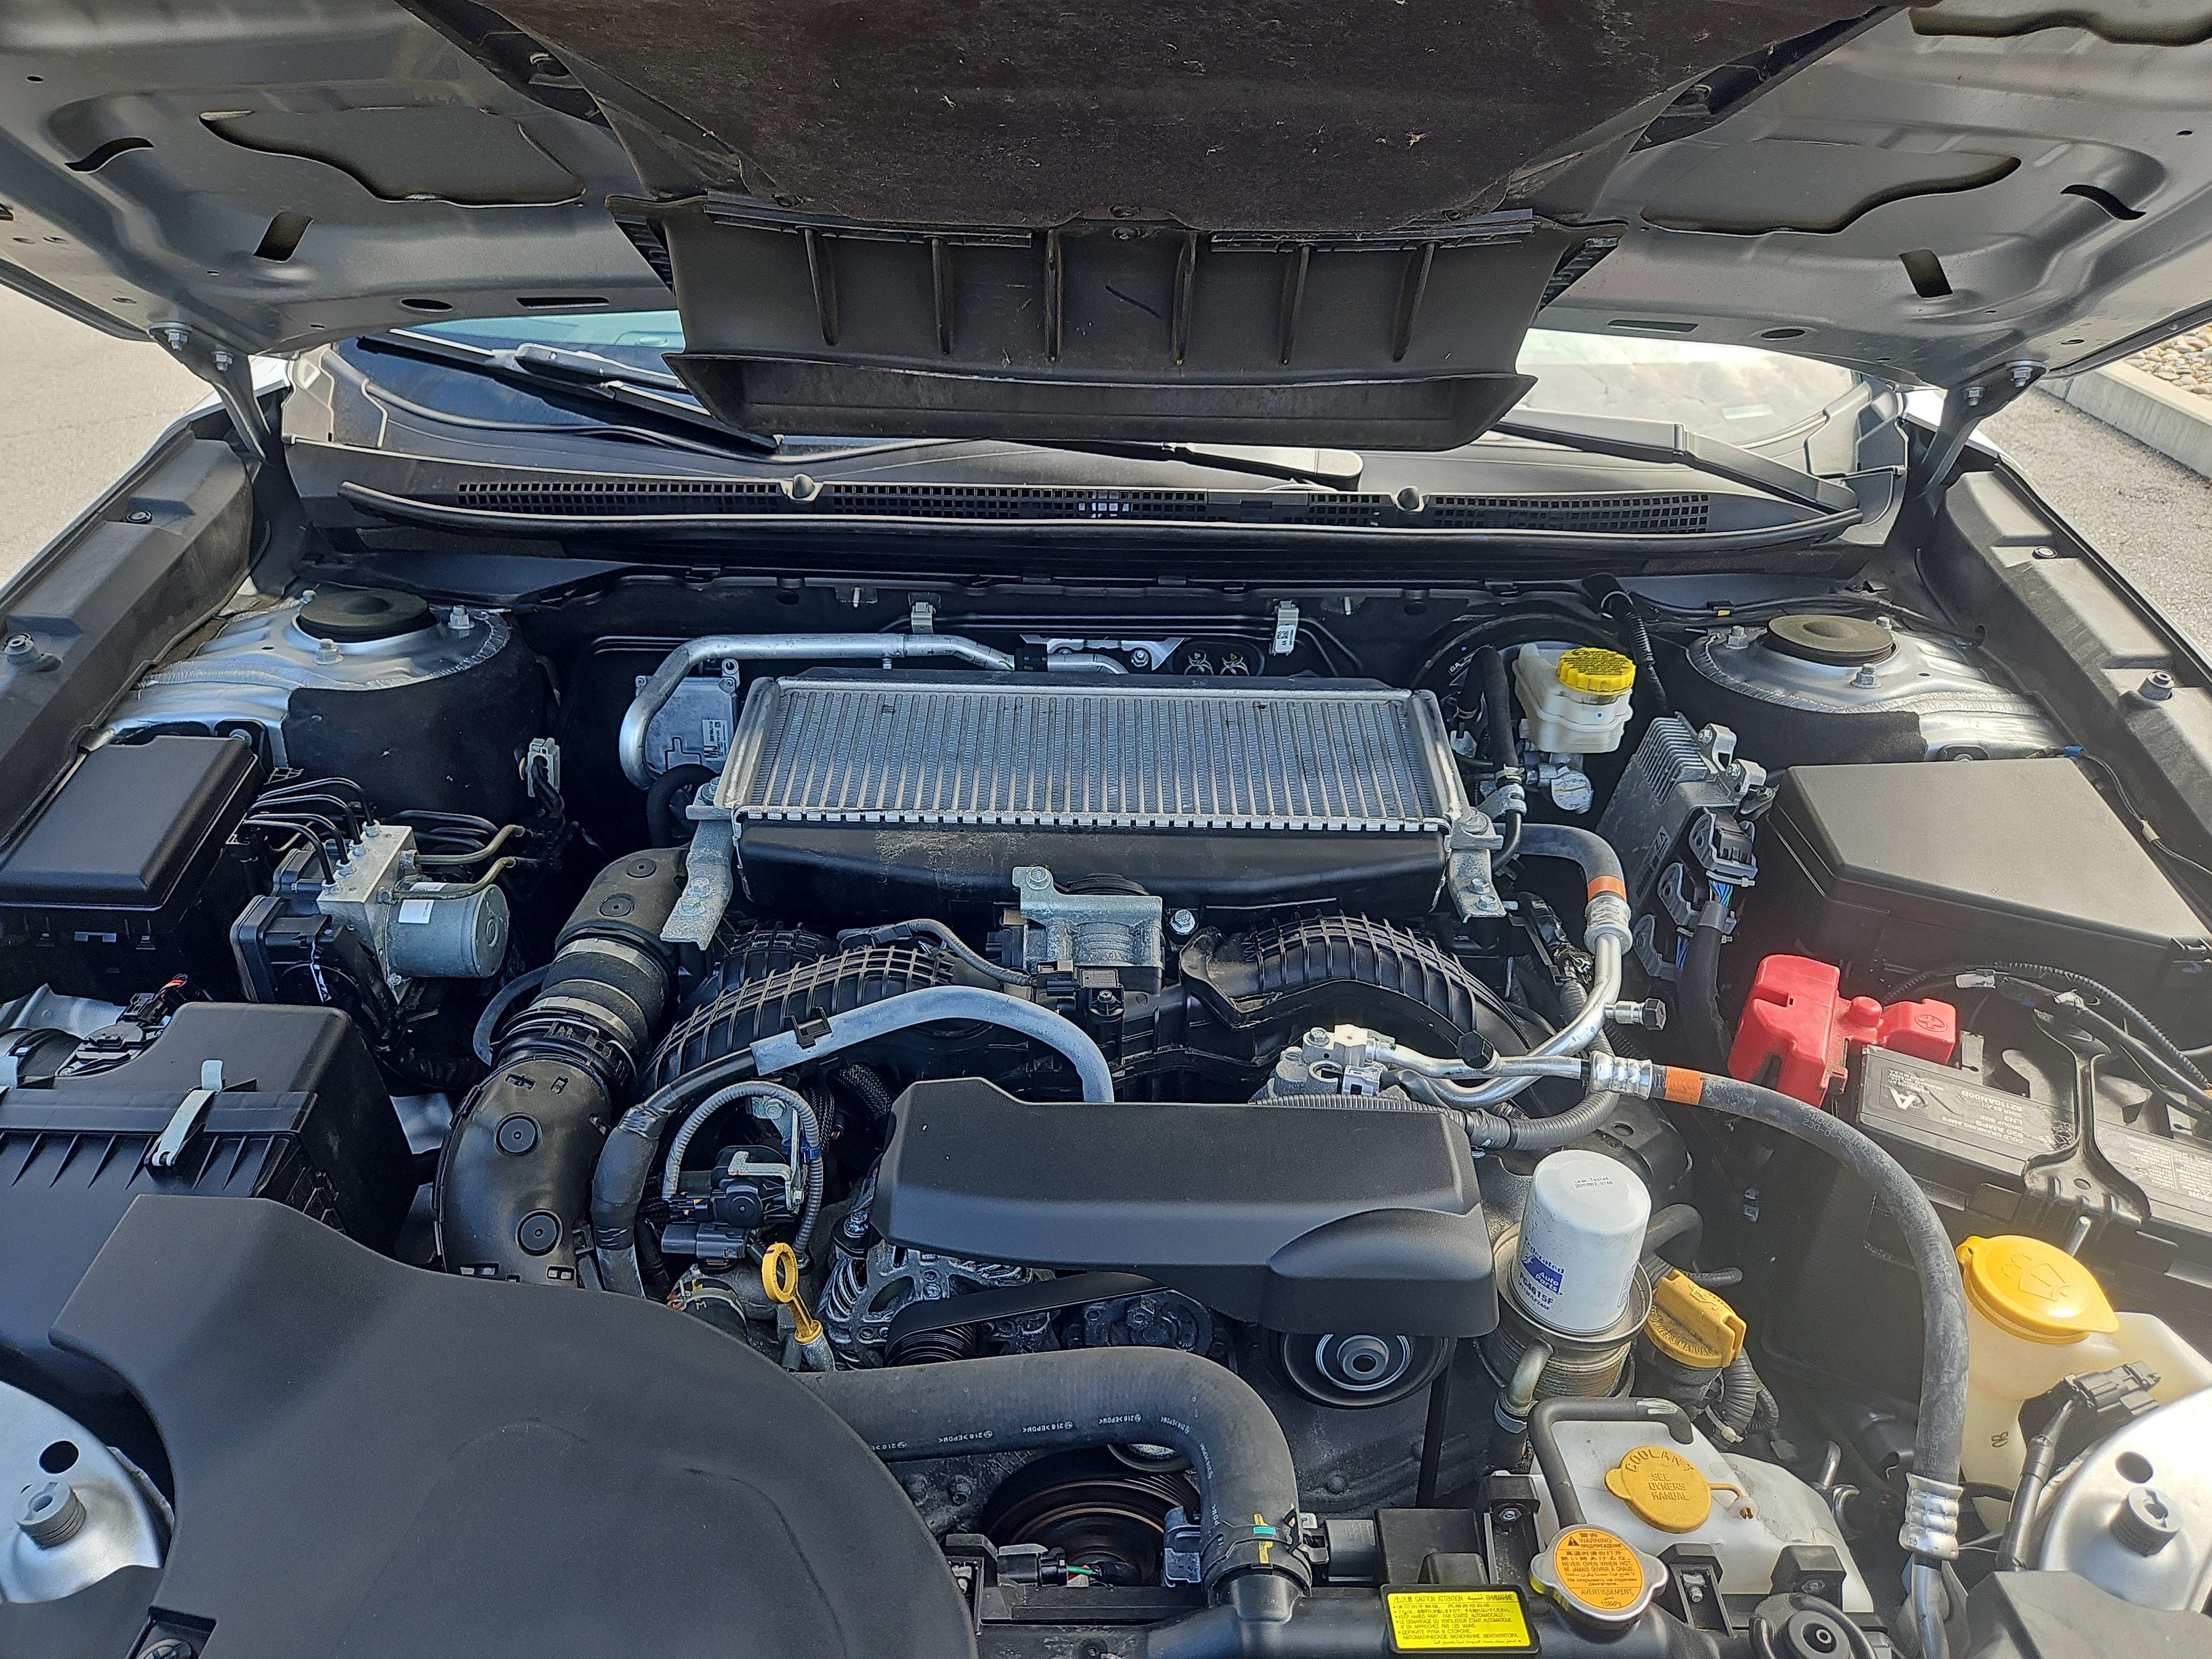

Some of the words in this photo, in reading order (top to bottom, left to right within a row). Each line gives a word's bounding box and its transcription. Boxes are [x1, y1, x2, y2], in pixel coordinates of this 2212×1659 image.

[704, 745, 718, 758] MJ
[1941, 1116, 1963, 1126] AMPS
[1979, 1114, 1996, 1122] SIZE
[2003, 1115, 2022, 1126] LN2
[1964, 1122, 2002, 1137] CRANKING
[1975, 1120, 2004, 1133] AMPS
[1997, 1120, 2023, 1131] GROUP
[2003, 1134, 2024, 1144] COLD
[1525, 1236, 1565, 1275] Federated
[1540, 1272, 1559, 1286] Auto
[1519, 1271, 1554, 1305] PG4615F
[1650, 1317, 1677, 1343] OWNER'S
[1677, 1341, 1713, 1356] MANUAL
[1625, 1449, 1694, 1472] COOLANT
[1651, 1472, 1670, 1481] SEE
[1648, 1482, 1687, 1491] OWNERS
[1651, 1491, 1690, 1501] MANUAL
